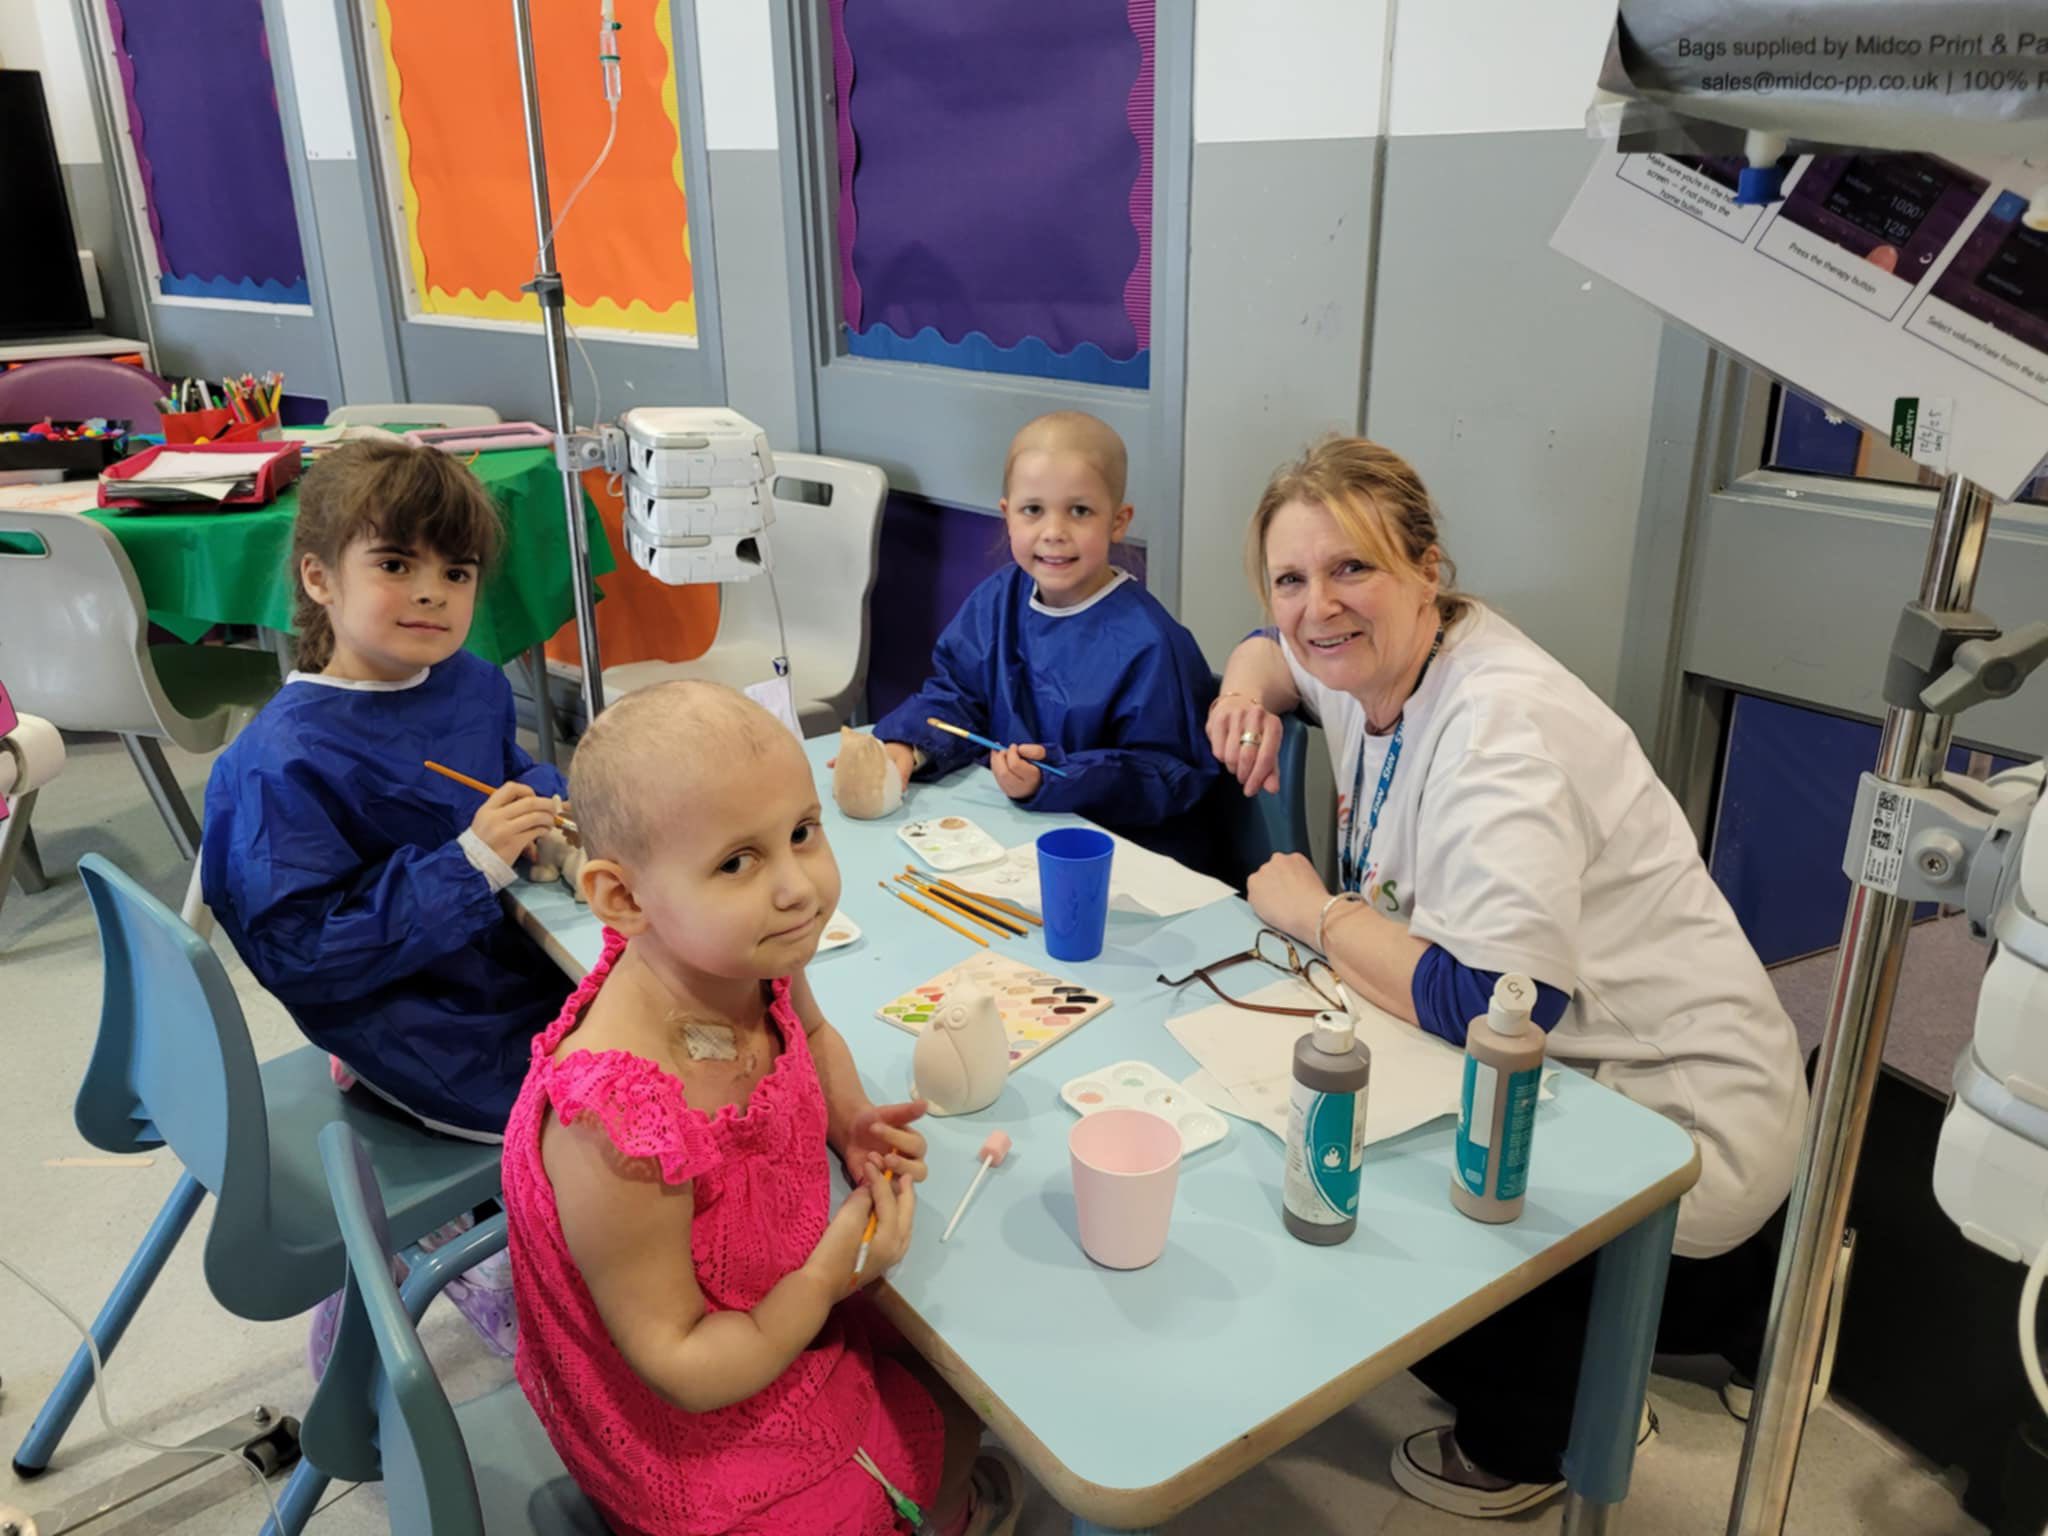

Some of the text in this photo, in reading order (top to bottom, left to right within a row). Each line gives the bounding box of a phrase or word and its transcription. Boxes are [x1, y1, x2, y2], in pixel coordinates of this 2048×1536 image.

[1678, 38, 1727, 61] Bags
[1733, 35, 1816, 59] supplied
[1824, 34, 1849, 60] by
[1856, 34, 1922, 55] Midco
[1929, 33, 1983, 55] Print
[1991, 33, 2007, 55] &
[1701, 70, 1939, 95] sales@midco-pp.co.uk
[1963, 69, 2028, 91] 100%
[1646, 153, 1666, 169] Make
[1666, 163, 1682, 177] sure
[1681, 172, 1702, 187] you're
[1703, 182, 1711, 192] in
[1711, 186, 1723, 200] the
[1646, 169, 1670, 185] screen
[1686, 189, 1698, 201] not
[1697, 194, 1718, 211] press
[1718, 204, 1731, 217] the
[1660, 188, 1703, 217] home button
[1789, 241, 1877, 294] Press the therapy button
[1927, 315, 1952, 336] Select
[2000, 353, 2020, 371] from
[2021, 366, 2035, 379] the
[1896, 424, 1904, 442] FOR
[1904, 408, 1916, 441] SAFETY
[1382, 752, 1396, 782] NHS
